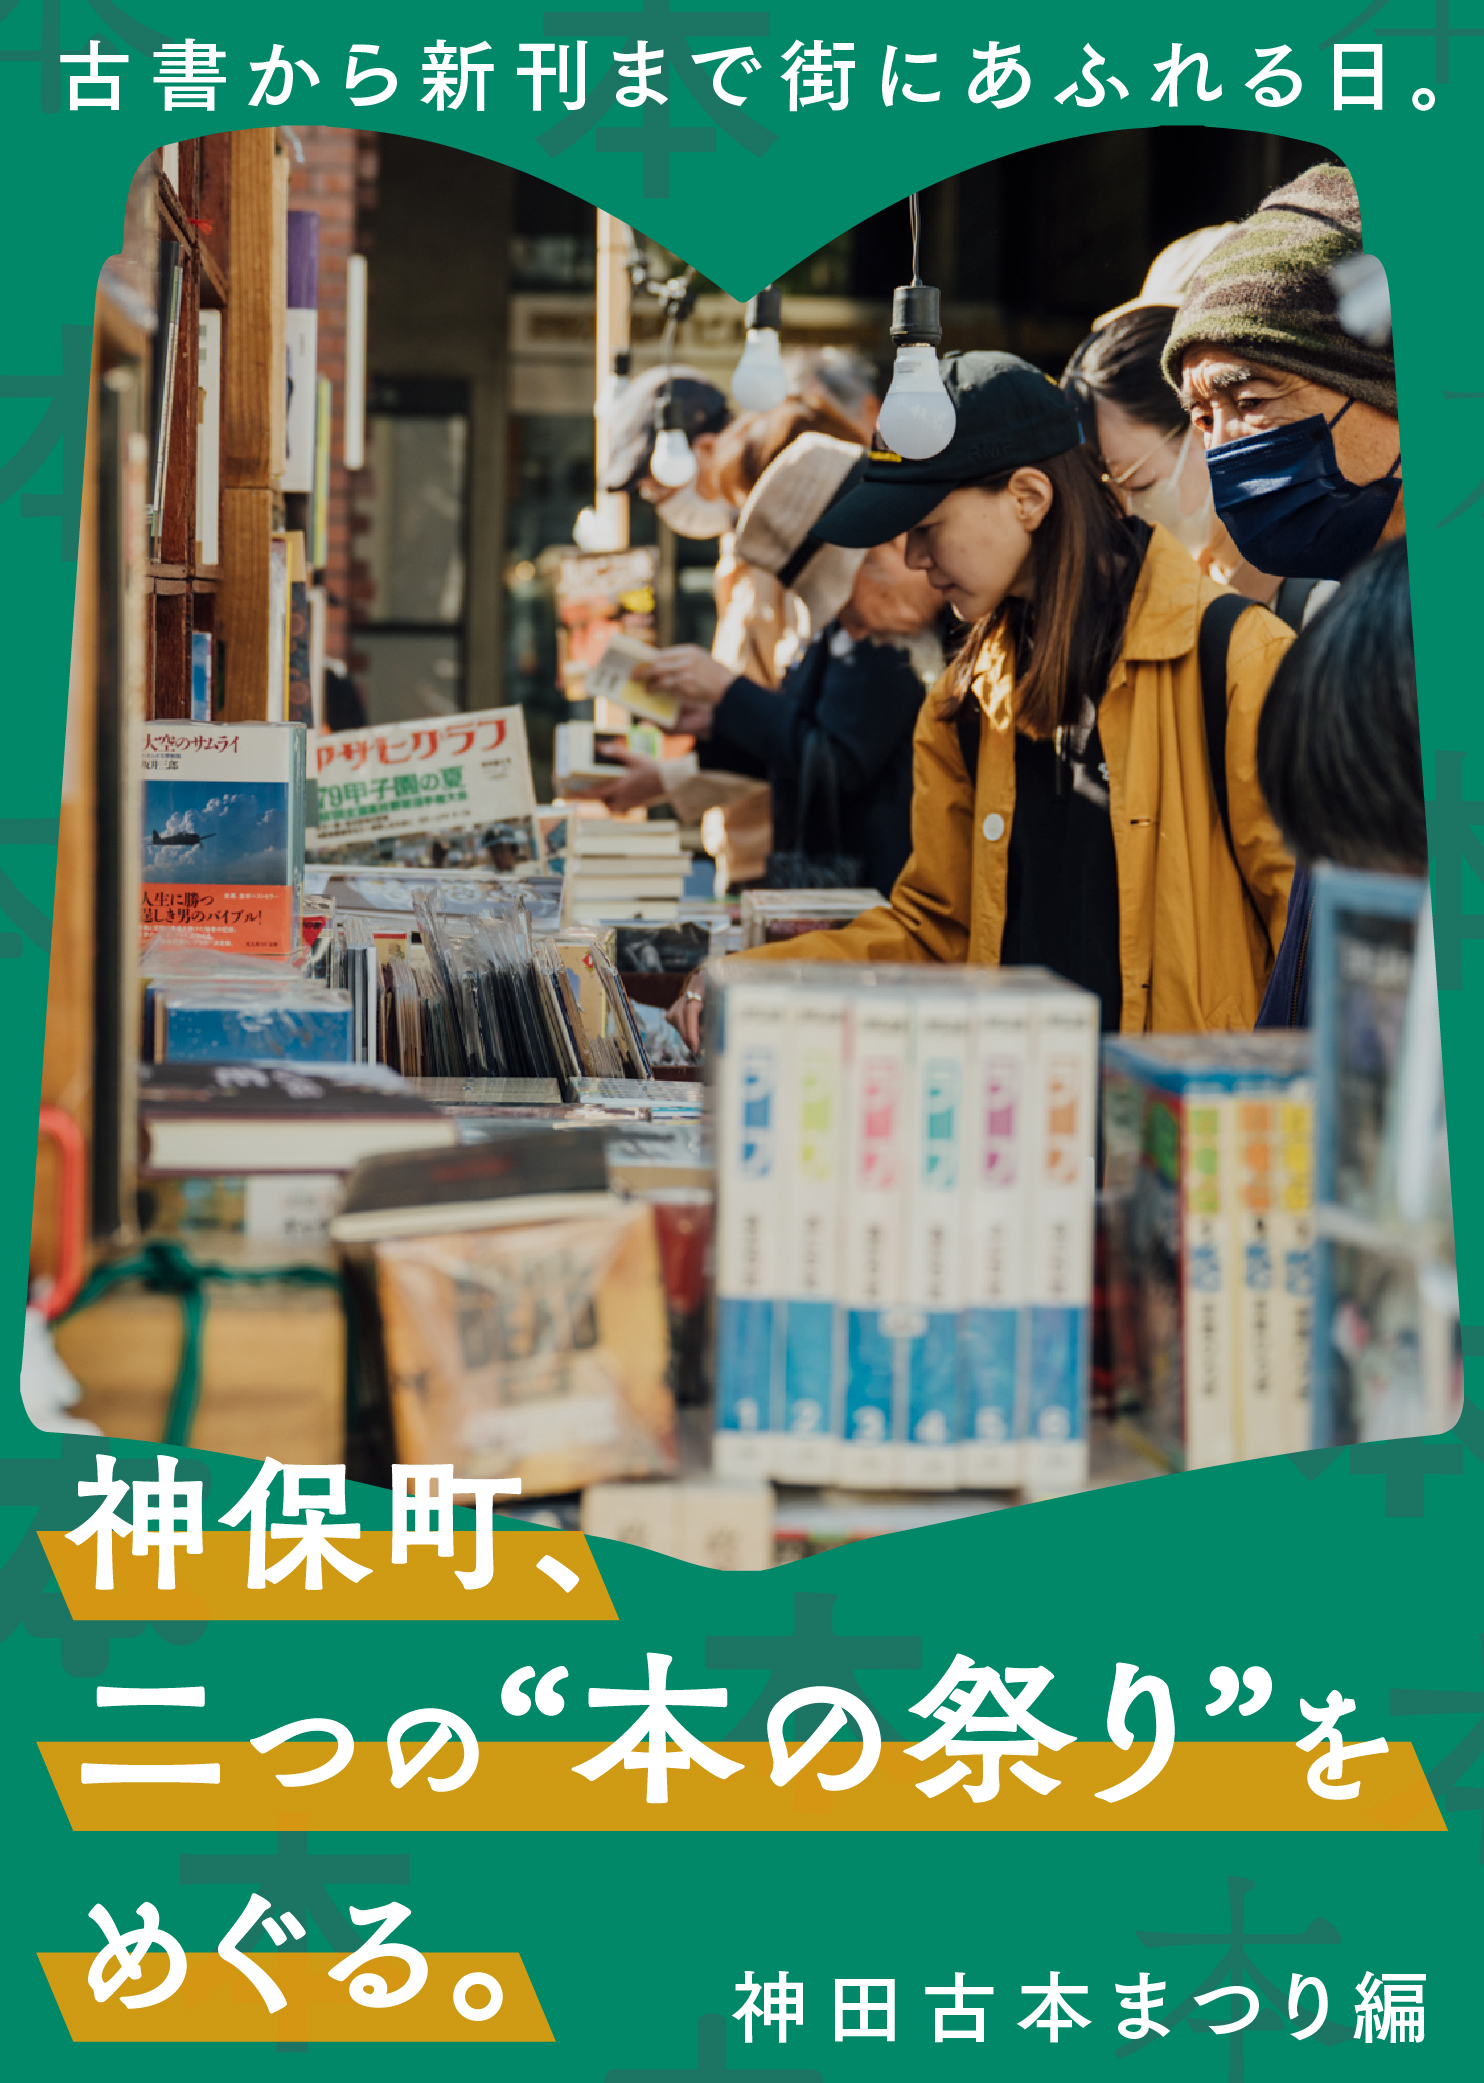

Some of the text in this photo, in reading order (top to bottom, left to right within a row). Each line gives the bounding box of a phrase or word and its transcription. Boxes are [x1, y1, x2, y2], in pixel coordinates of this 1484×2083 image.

[141, 891, 215, 909] 人生に勝つ
